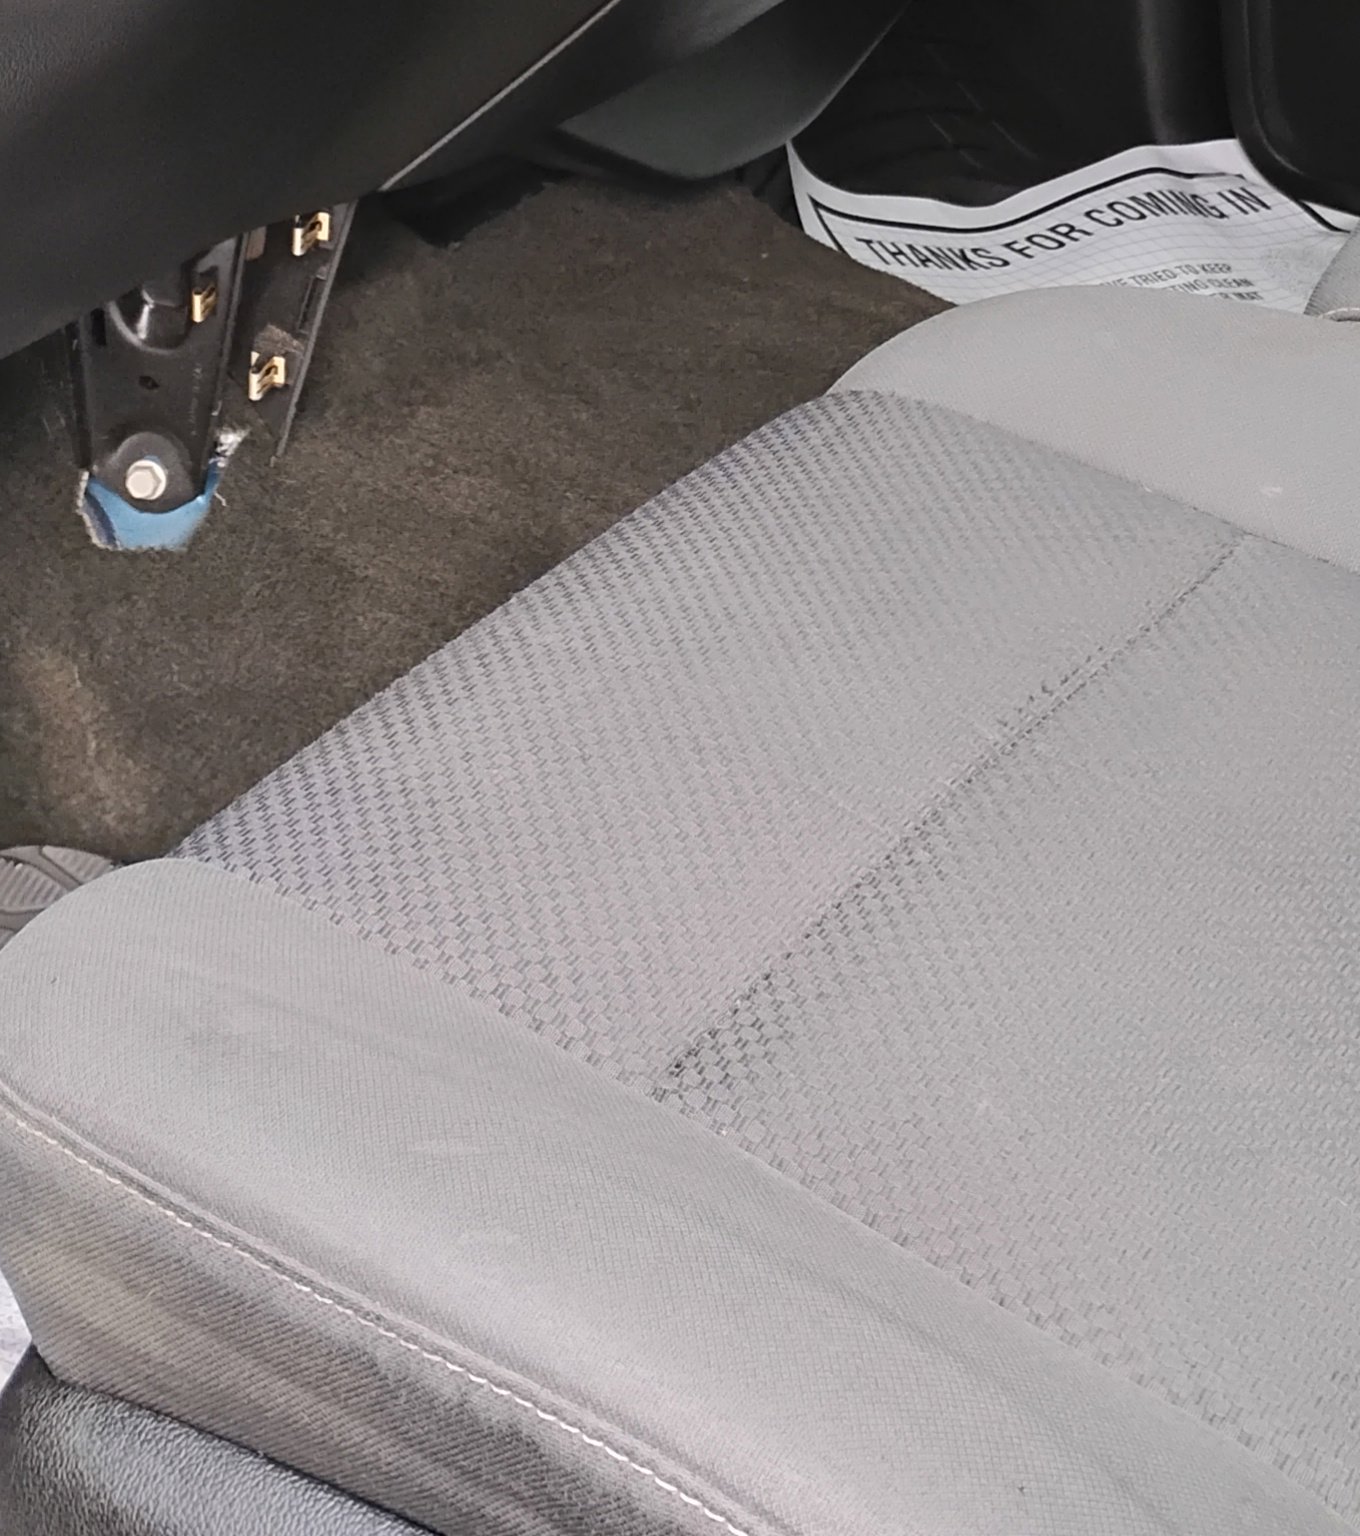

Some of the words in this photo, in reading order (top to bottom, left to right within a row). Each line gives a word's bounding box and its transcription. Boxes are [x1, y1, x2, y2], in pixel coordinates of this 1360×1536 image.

[855, 237, 1010, 271] THANKS
[1002, 222, 1094, 259] FOR
[1084, 189, 1230, 227] COMING
[1217, 187, 1272, 215] IN
[1128, 269, 1178, 286] TRIED
[1174, 264, 1200, 276] TO
